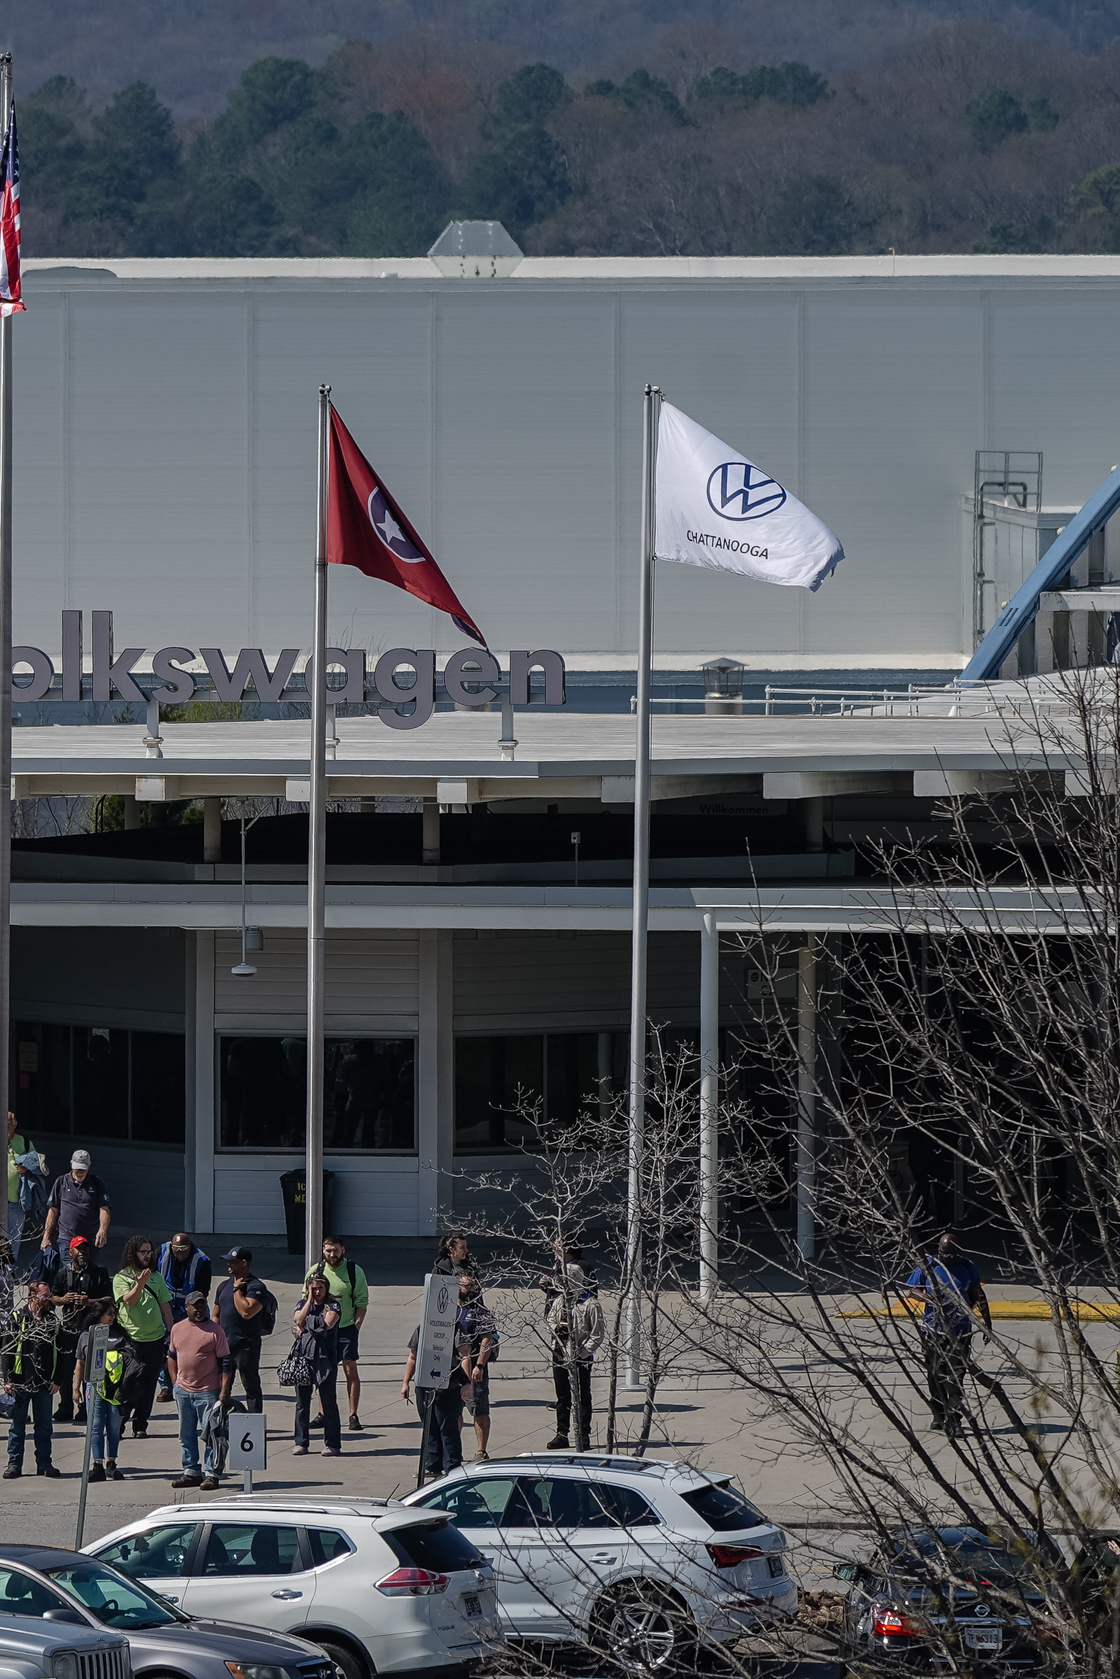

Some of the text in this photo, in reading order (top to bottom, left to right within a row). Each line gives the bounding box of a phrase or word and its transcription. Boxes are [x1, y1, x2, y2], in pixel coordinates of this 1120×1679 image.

[686, 529, 769, 560] CHATTANOOGA
[700, 804, 769, 815] Willkommen
[297, 1182, 306, 1191] IC
[294, 1194, 306, 1203] ME
[240, 1432, 253, 1452] 6
